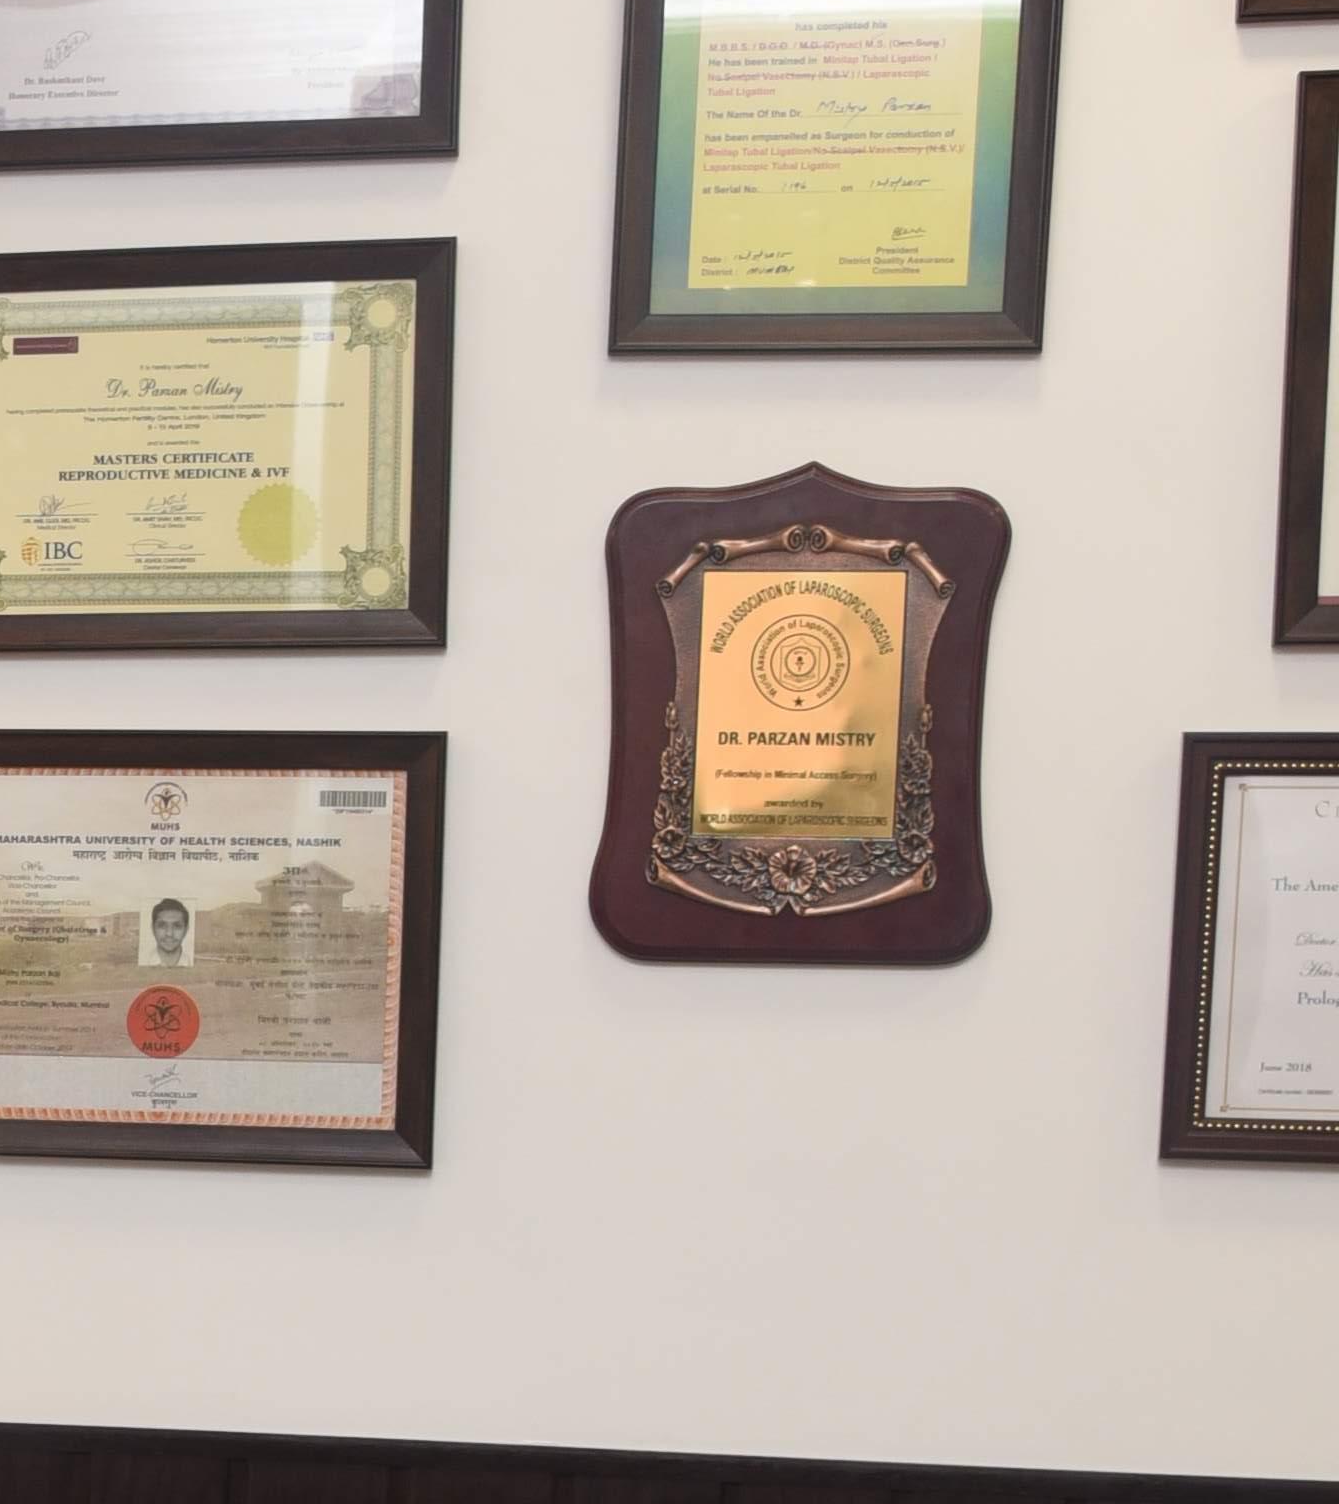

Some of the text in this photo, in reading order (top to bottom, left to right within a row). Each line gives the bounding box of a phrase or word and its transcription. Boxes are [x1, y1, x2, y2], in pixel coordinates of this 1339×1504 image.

[105, 376, 244, 403] Dr. Parzan Mistry
[92, 451, 254, 465] MASTERS CERTIFICATE
[57, 466, 290, 482] REPRODUCTIVE MEDICINE & IVF
[43, 540, 83, 560] IBC
[709, 580, 894, 656] WORLD ASSOCIATION OF LAPAROSCOPIC SURGEONS
[717, 730, 876, 746] DR. PARZAN MISTRY
[84, 834, 156, 846] UNIVERSITY
[158, 835, 175, 846] OF
[178, 835, 226, 846] HEALTH
[229, 836, 292, 847] SCIENCES,
[295, 837, 342, 847] NASHIK
